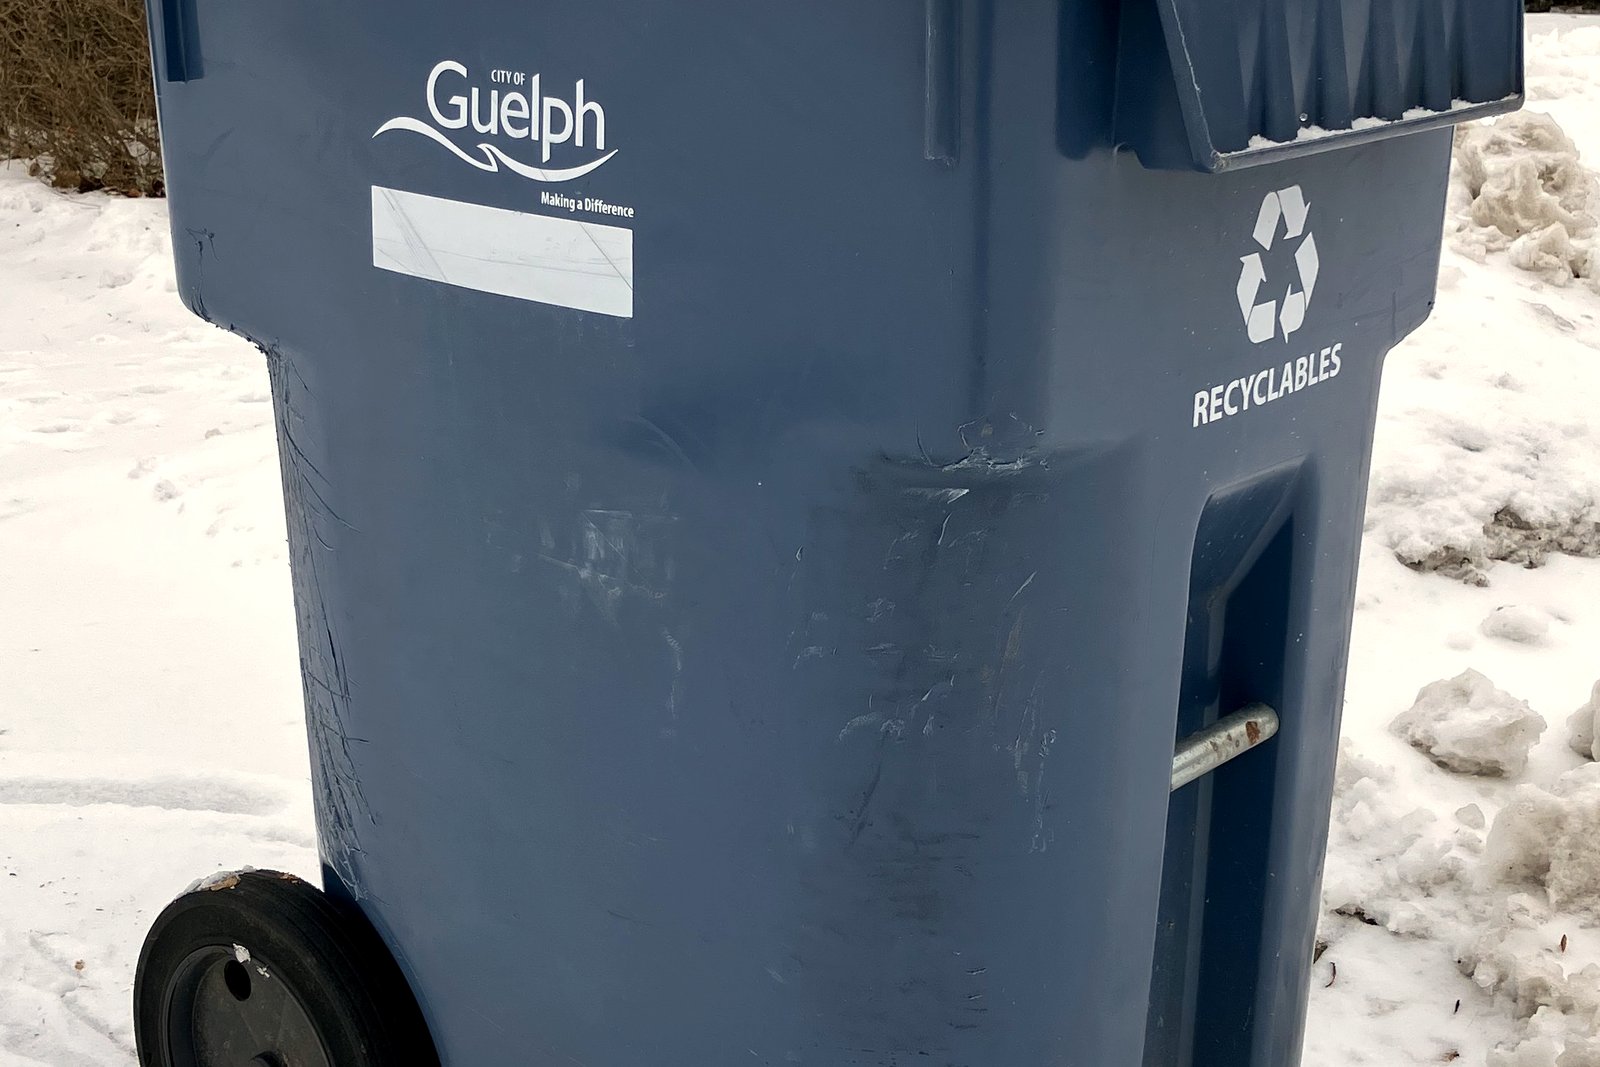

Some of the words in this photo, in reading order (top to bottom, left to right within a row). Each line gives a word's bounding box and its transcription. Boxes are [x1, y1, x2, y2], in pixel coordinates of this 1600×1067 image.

[491, 69, 512, 84] CITY
[514, 71, 526, 86] OF
[427, 60, 605, 164] Guelph
[541, 191, 576, 213] Making
[577, 199, 583, 211] a
[584, 197, 635, 218] Difference
[1193, 342, 1343, 428] RECYCLABLES
